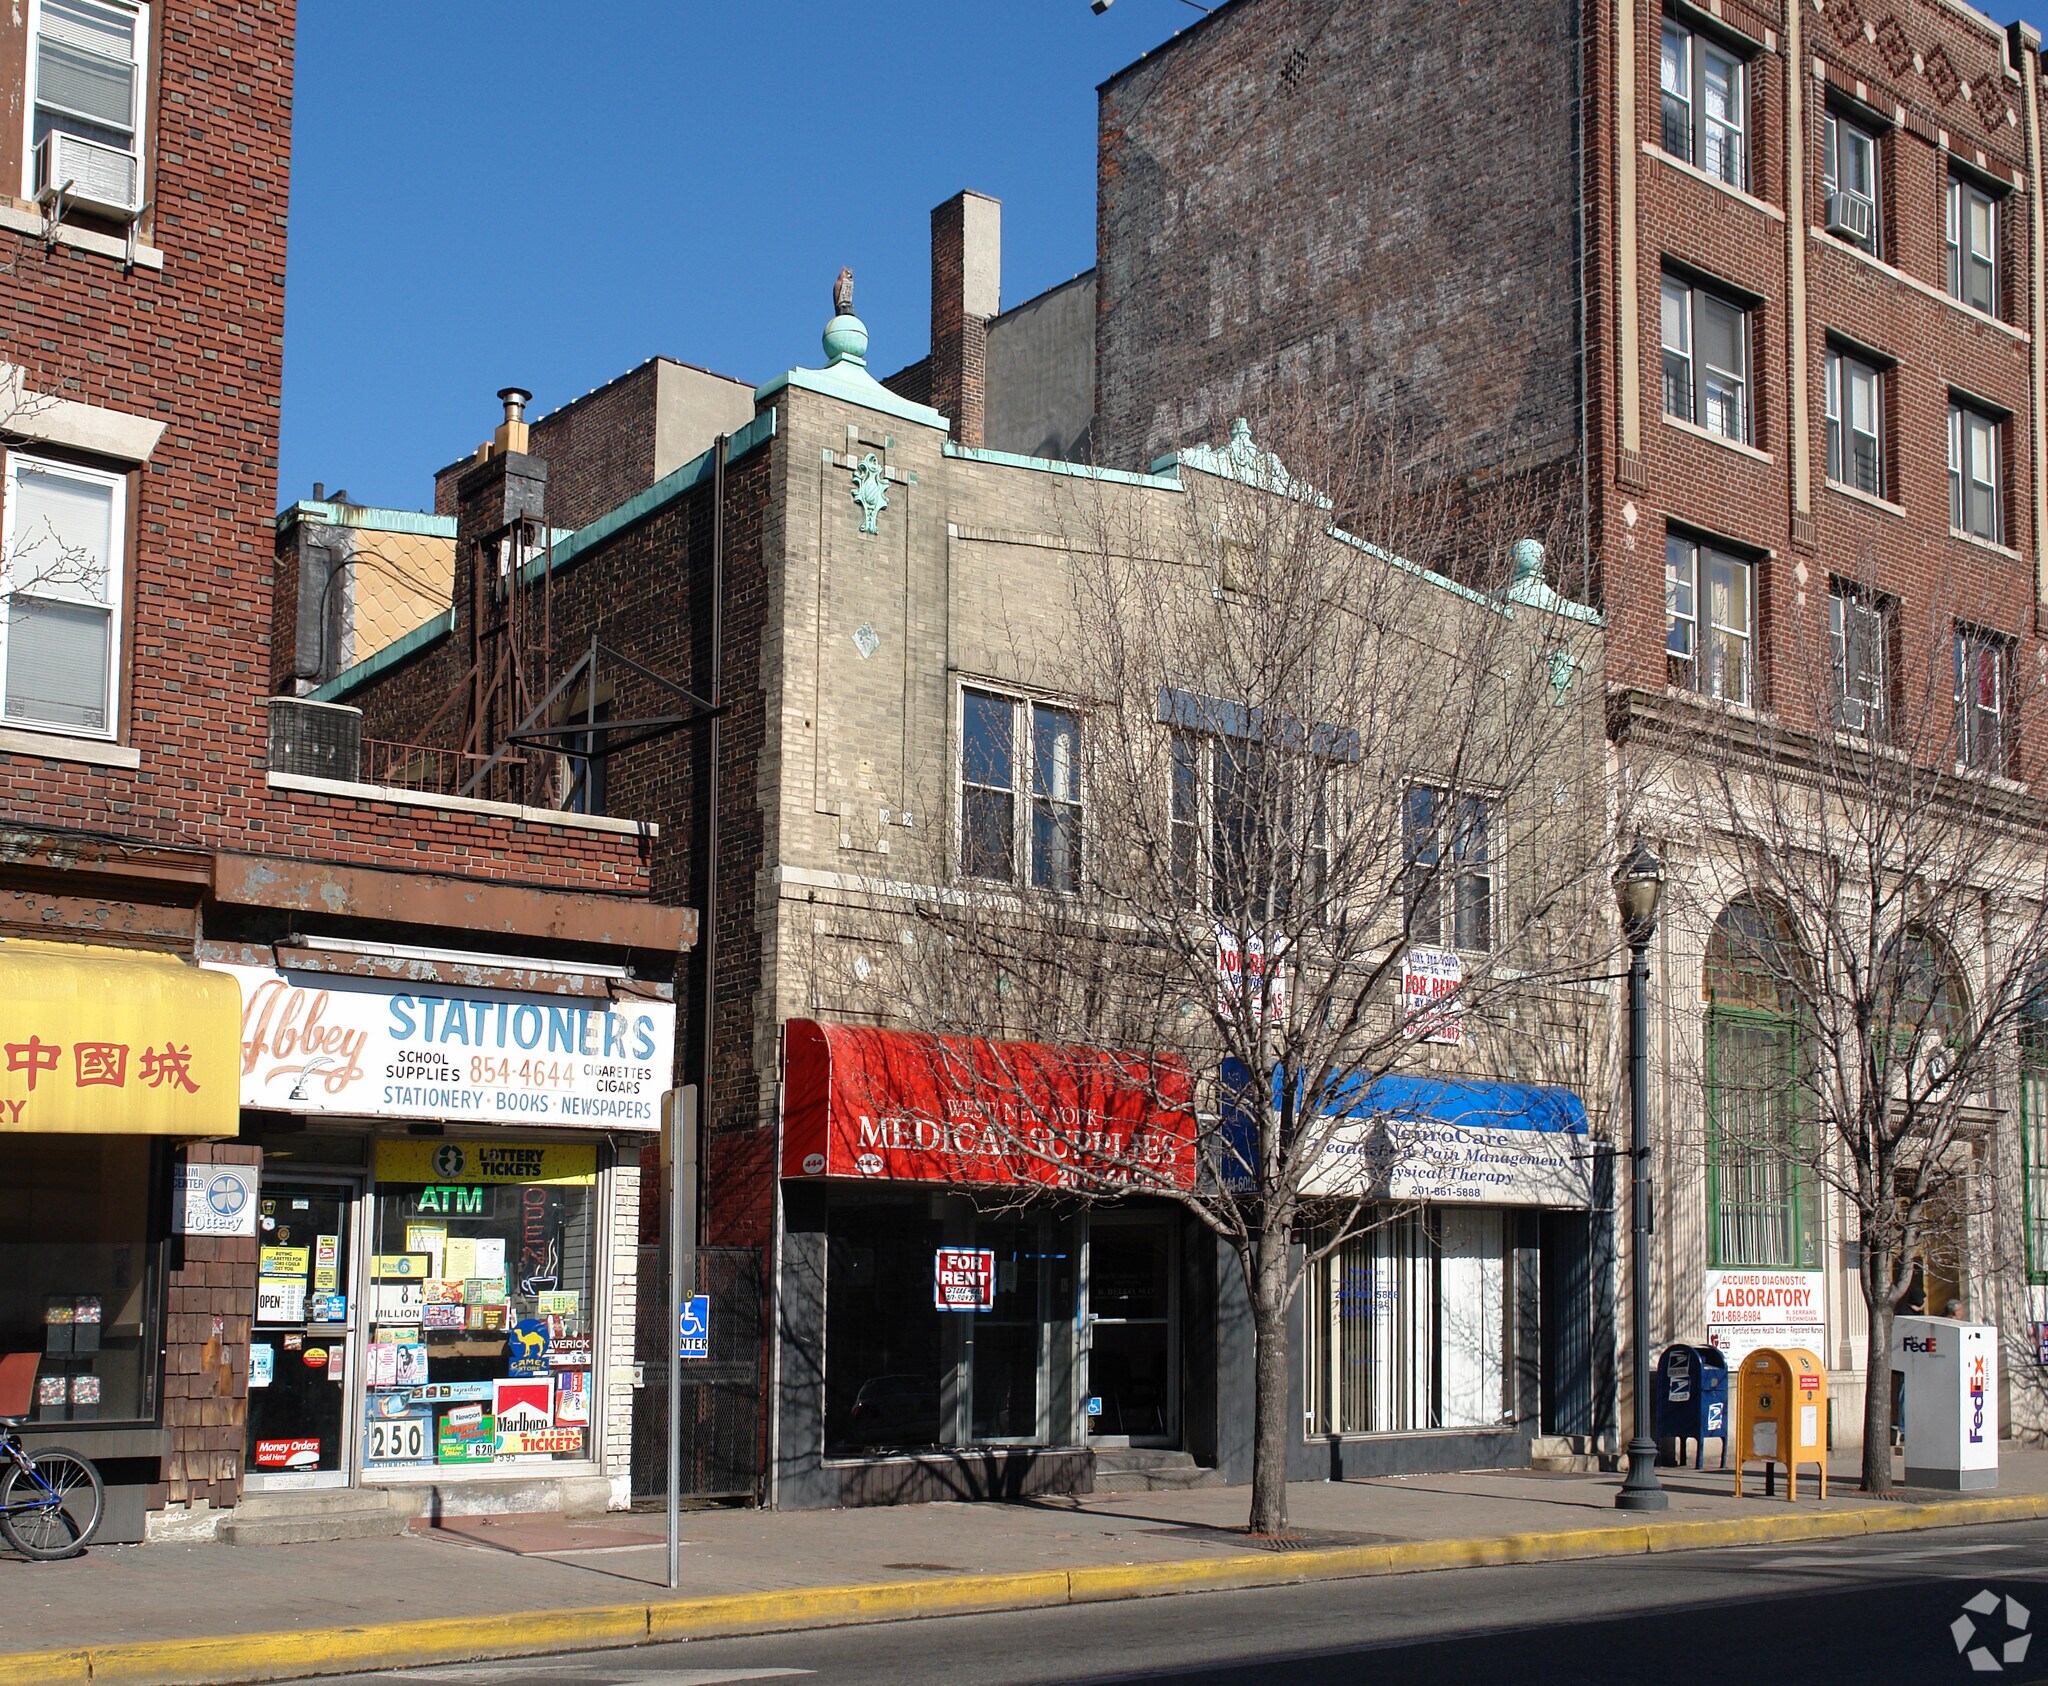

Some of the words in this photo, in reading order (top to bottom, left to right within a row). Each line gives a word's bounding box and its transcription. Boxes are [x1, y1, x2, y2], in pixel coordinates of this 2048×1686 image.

[1405, 974, 1427, 996] FOR
[388, 992, 656, 1060] STATIONERS
[241, 980, 368, 1094] Abbey
[4, 1035, 200, 1093] 中國城
[398, 1050, 449, 1066] SCHOOL
[386, 1065, 460, 1082] SUPPLIES
[470, 1055, 576, 1088] 854-4644
[583, 1063, 652, 1080] CIGARETTES
[596, 1080, 640, 1094] CIGARS
[384, 1086, 484, 1109] STATIONERY
[496, 1092, 549, 1113] BOOKS
[562, 1096, 652, 1119] NEWSPAPERS
[947, 1100, 996, 1118] WEST
[1004, 1103, 1045, 1123] NEW
[1051, 1106, 1098, 1126] YORK
[857, 1116, 1019, 1155] MEDICAL
[1030, 1128, 1176, 1166] SUPPLIES
[1384, 1124, 1508, 1146] NeuroCare
[479, 1148, 545, 1162] LOTTERY
[805, 1159, 822, 1167] 444
[1423, 1145, 1460, 1161] Pain
[1467, 1149, 1564, 1167] Management
[480, 1162, 541, 1176] TICKETS
[1450, 1167, 1514, 1185] Therapy
[417, 1185, 482, 1213] ATM
[1411, 1185, 1481, 1198] 201-861-5888
[180, 1208, 243, 1232] Lottery
[523, 1187, 547, 1265] OPEN
[947, 1255, 982, 1270] FOR
[941, 1271, 988, 1285] RENT
[1722, 1275, 1760, 1285] ACCUMED
[1762, 1276, 1807, 1285] DIAGNOSTIC
[260, 1295, 280, 1308] OPEN
[1716, 1288, 1811, 1307] LABORATORY
[375, 1309, 419, 1318] MILLION
[1711, 1310, 1761, 1322] 201-868-6984
[1732, 1327, 1749, 1335] Certified
[1790, 1326, 1810, 1335] Registered
[549, 1340, 589, 1348] AVERICK
[681, 1338, 707, 1349] NTER
[511, 1359, 547, 1369] CAMEL
[1970, 1355, 1984, 1443] FedEx
[456, 1412, 480, 1421] Newport
[497, 1412, 547, 1432] Marlboro
[258, 1442, 289, 1453] Money
[290, 1440, 318, 1451] Orders
[372, 1425, 421, 1456] 250
[521, 1437, 581, 1451] TICKETS
[475, 1444, 492, 1456] 620
